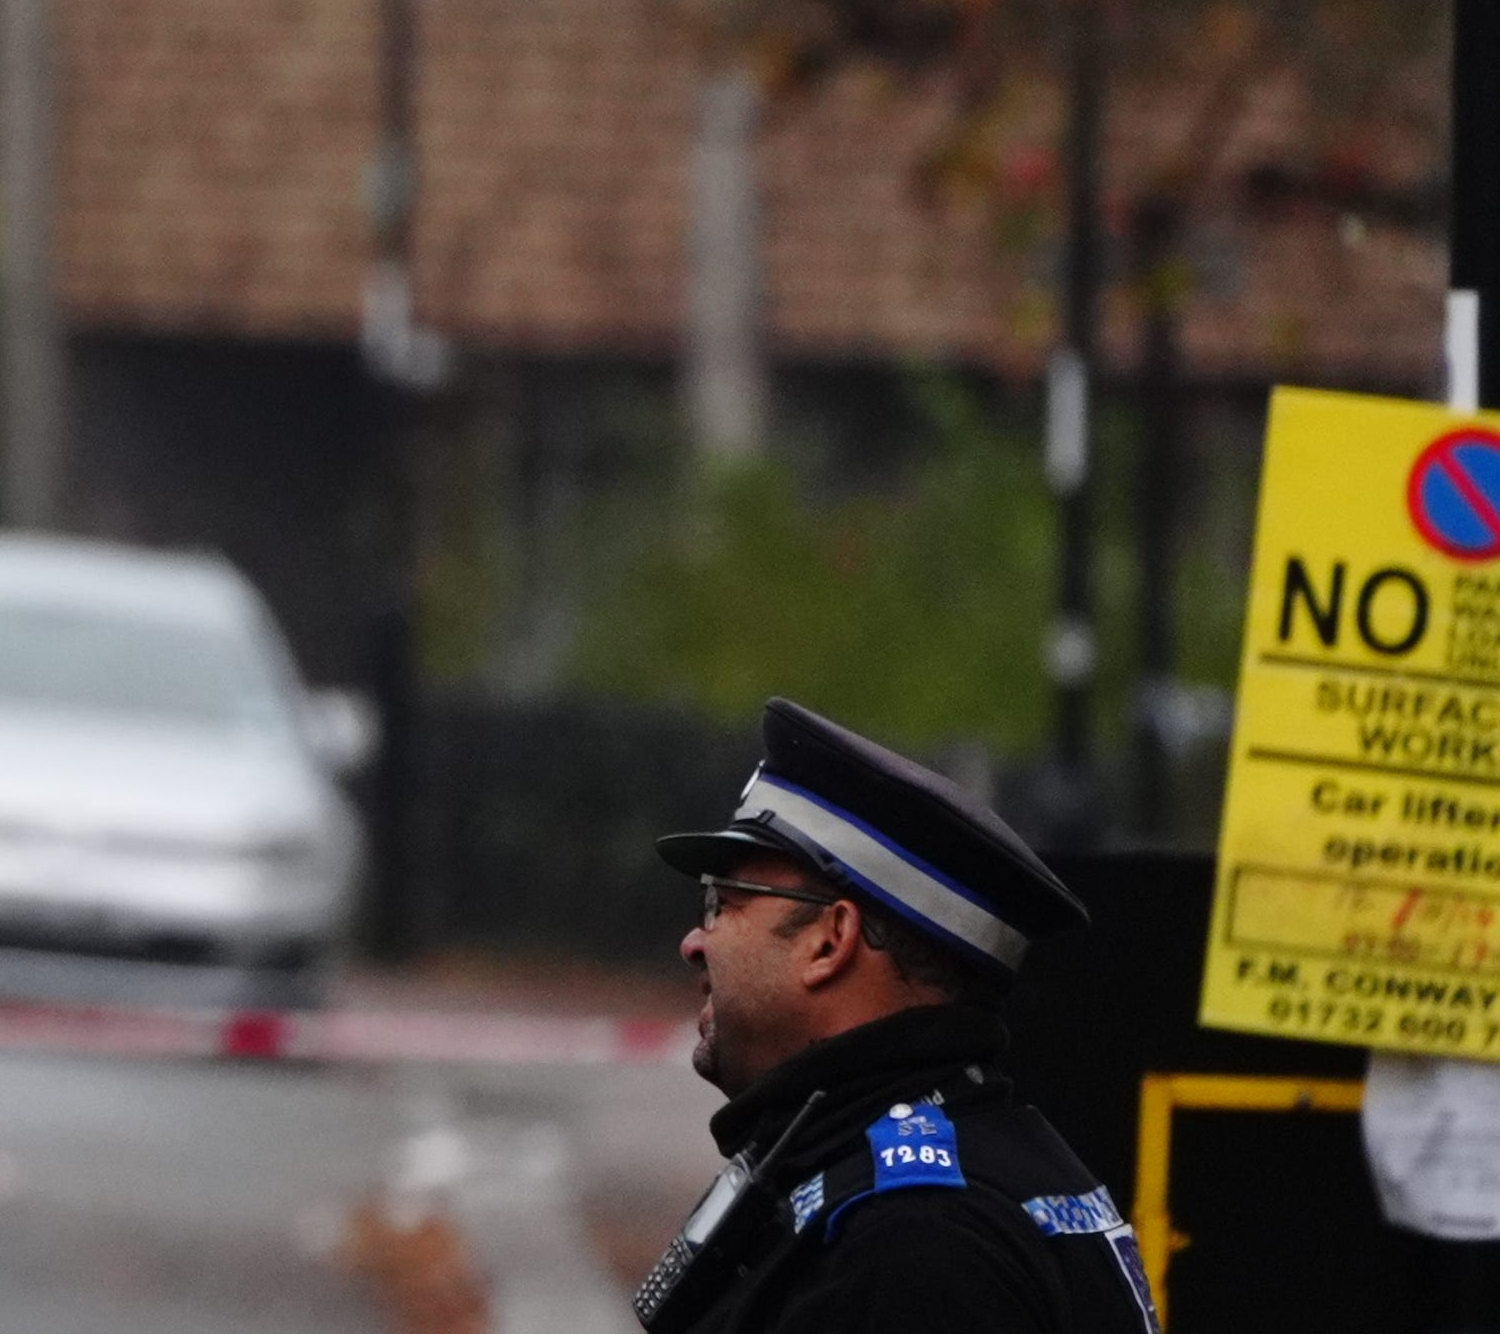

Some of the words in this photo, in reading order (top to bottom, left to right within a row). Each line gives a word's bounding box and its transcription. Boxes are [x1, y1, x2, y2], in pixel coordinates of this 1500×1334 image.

[1278, 556, 1431, 658] NO
[1311, 778, 1388, 815] Car
[1325, 968, 1499, 1010] CONWAY
[1268, 995, 1384, 1033] 01732
[880, 1145, 952, 1167] 7283
